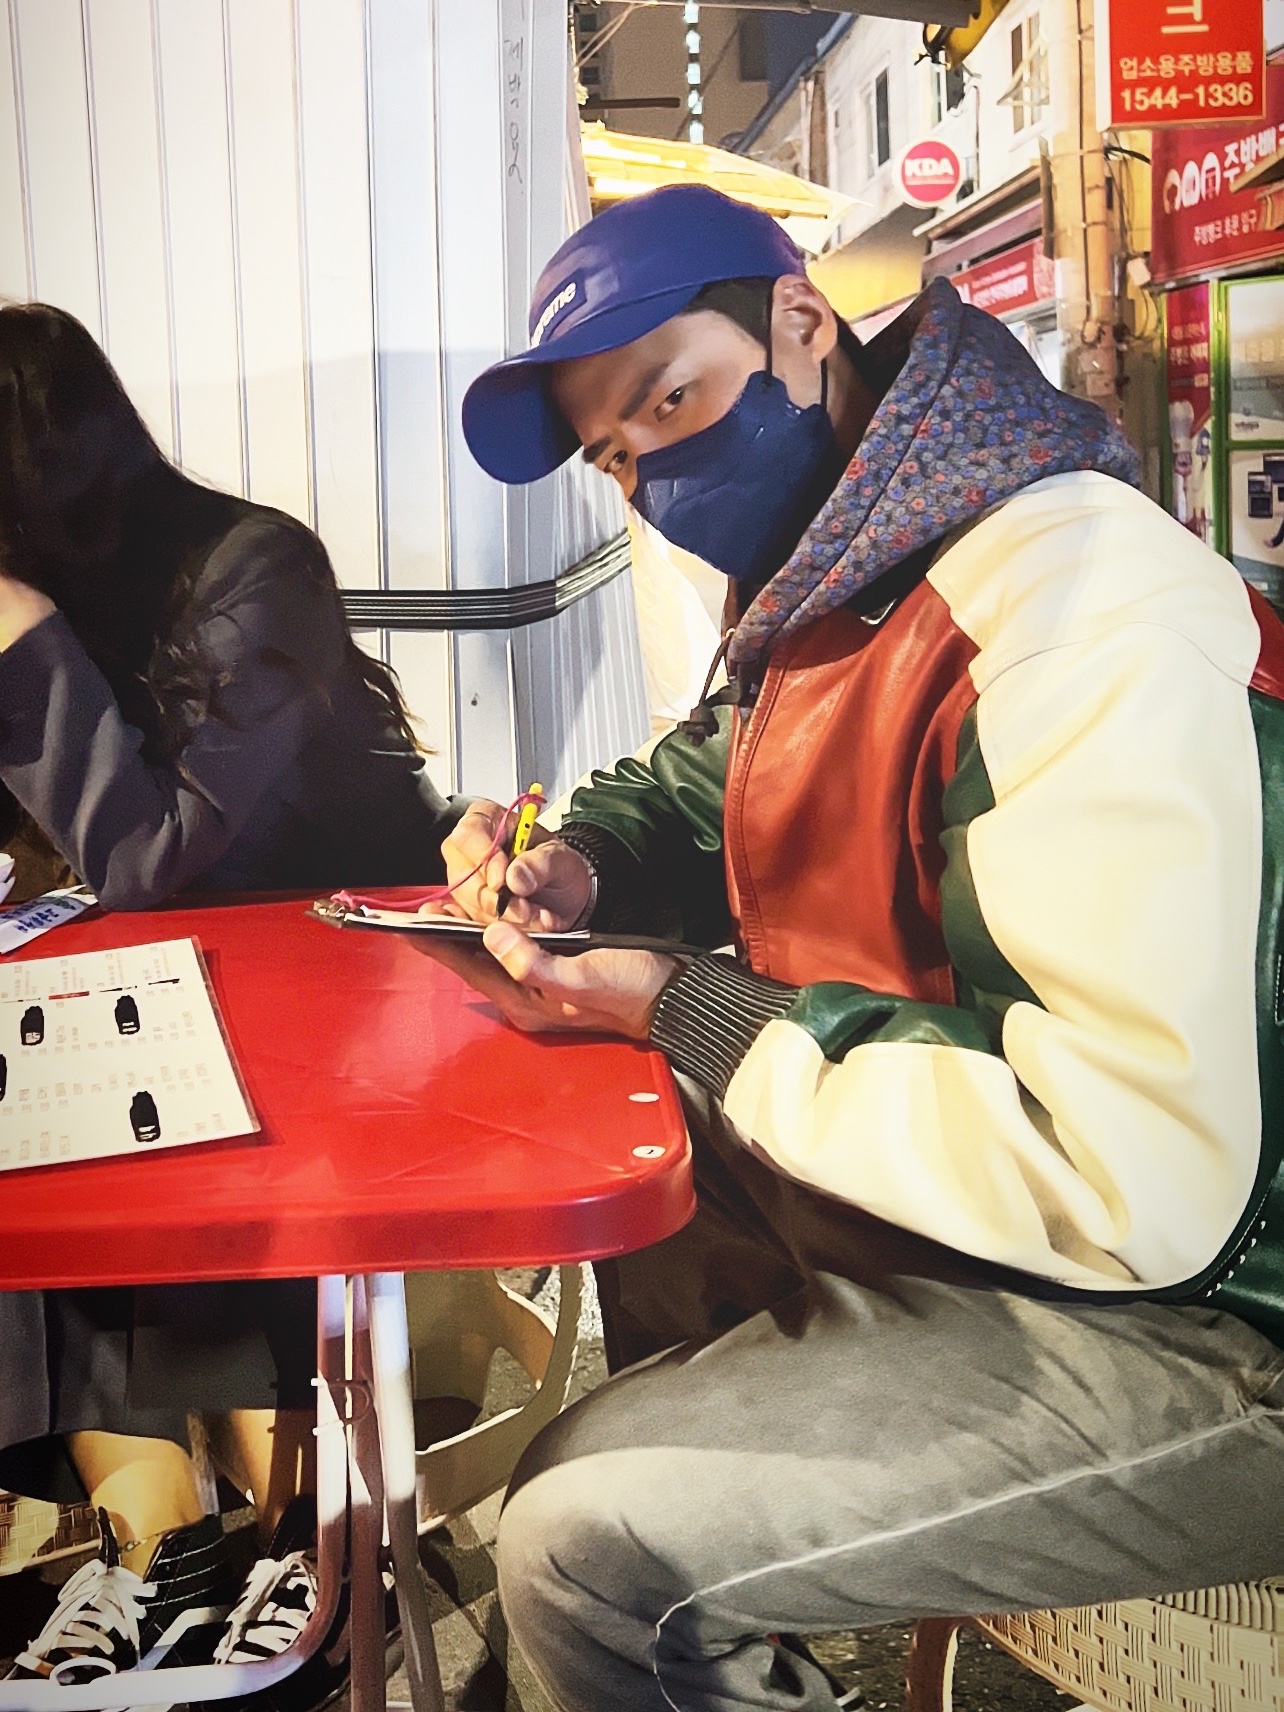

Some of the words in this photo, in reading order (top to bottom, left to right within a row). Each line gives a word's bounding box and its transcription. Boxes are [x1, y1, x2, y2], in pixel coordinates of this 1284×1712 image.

[1120, 51, 1254, 80] 업소용주방용품
[1121, 82, 1253, 112] 1544-1336
[904, 156, 955, 177] KDA
